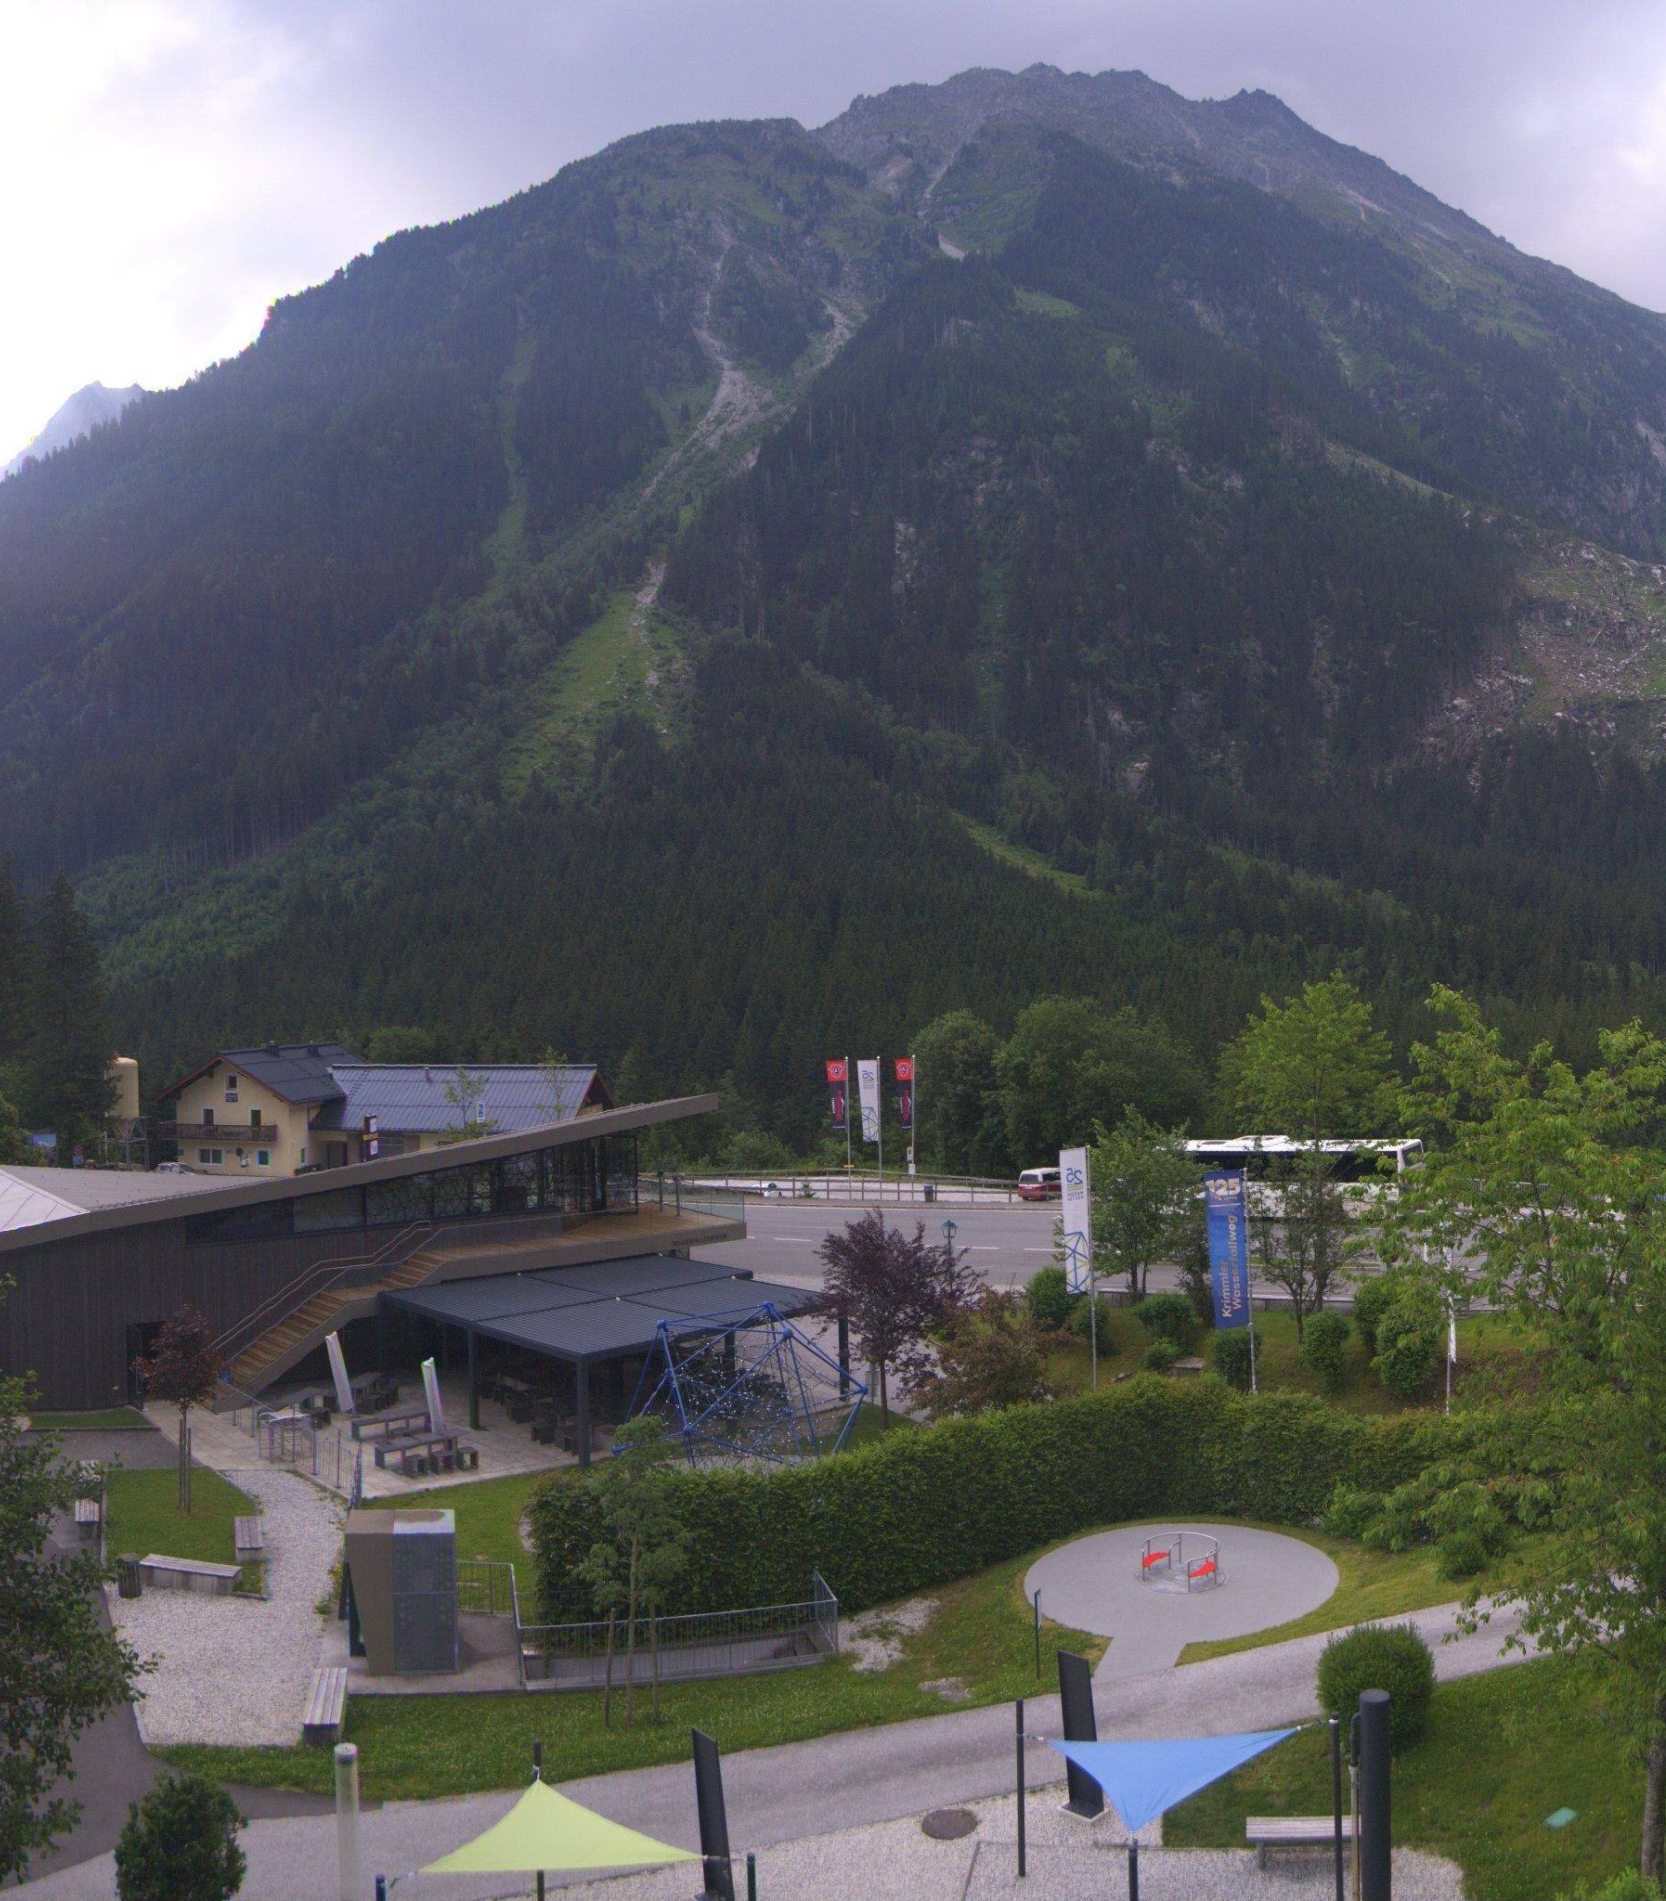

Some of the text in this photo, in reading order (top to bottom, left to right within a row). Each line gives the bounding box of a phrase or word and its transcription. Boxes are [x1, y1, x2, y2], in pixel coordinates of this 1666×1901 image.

[1205, 1178, 1241, 1196] 125
[1218, 1259, 1232, 1318] Krimmler
[1228, 1215, 1242, 1311] Wasserfallweg
